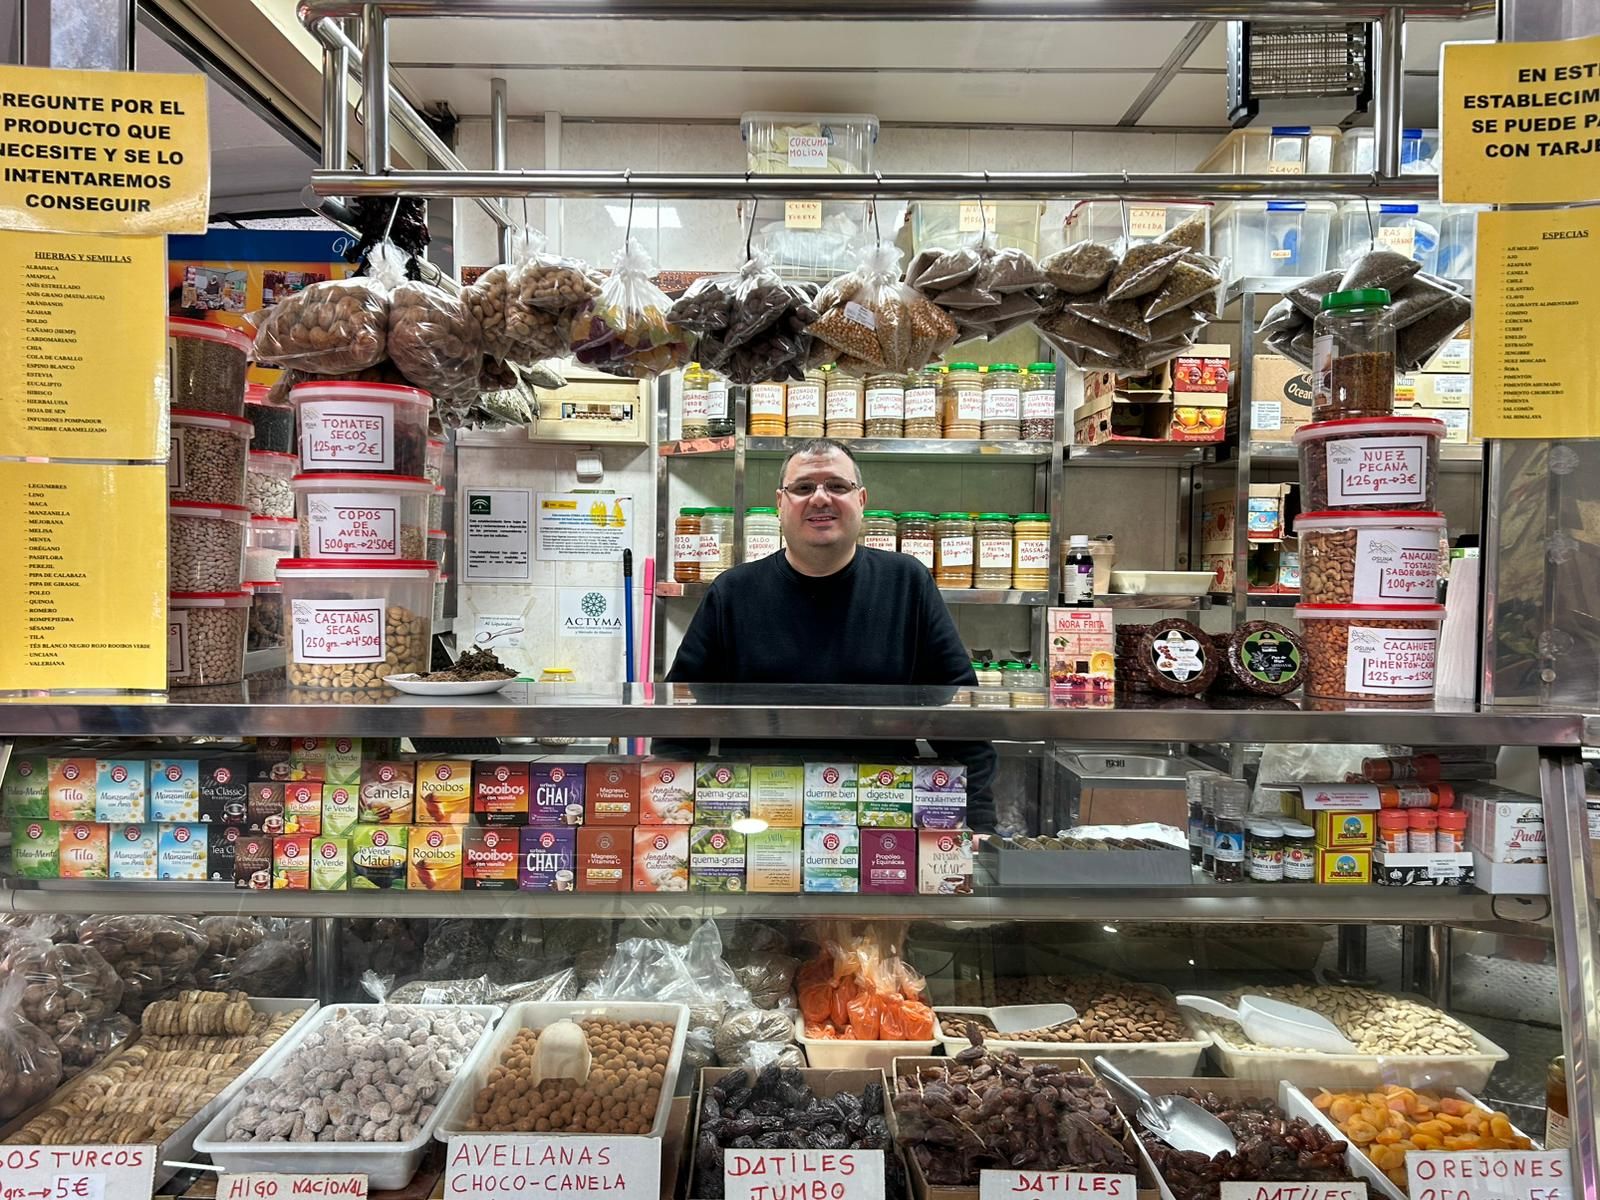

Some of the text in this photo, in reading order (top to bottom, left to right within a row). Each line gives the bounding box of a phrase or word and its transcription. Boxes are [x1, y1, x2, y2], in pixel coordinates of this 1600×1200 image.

[1519, 63, 1600, 82] EN EST
[111, 99, 153, 114] POR
[160, 101, 185, 115] EL
[4, 118, 170, 139] PRODUCTO QUE
[1472, 120, 1497, 133] SE
[1505, 116, 1576, 132] PUEDE
[1486, 144, 1529, 157] CON
[104, 148, 117, 161] Y
[124, 149, 150, 163] SE
[158, 151, 183, 165] LO
[4, 168, 170, 188] INTENTAREMOS
[26, 194, 150, 212] CONSEGUIR
[1542, 230, 1589, 240] ESPECIAS
[35, 252, 76, 260] HIERBAS
[86, 254, 132, 263] SEMILLAS
[321, 419, 379, 430] TOMATES
[330, 430, 366, 440] SECOS
[357, 442, 379, 455] 2€
[1364, 451, 1405, 461] NUEZ
[1360, 462, 1408, 472] PECANA
[1400, 474, 1416, 485] 3€
[338, 511, 381, 520] COPOS
[1386, 568, 1414, 576] SABOR
[315, 612, 374, 624] CASTAÑAS
[565, 618, 622, 626] ACTYMA
[1059, 618, 1080, 628] ÑORA
[326, 626, 360, 635] SECAS
[201, 787, 242, 795] Tea Classic
[364, 785, 410, 799] Canela
[421, 781, 464, 792] Rooibos
[479, 783, 524, 794] Rooibos
[60, 788, 83, 800] Tila
[101, 792, 138, 801] Manzanilla
[537, 788, 568, 806] CHAI
[698, 790, 748, 799] quema-grasa
[806, 789, 855, 798] duerme bien
[867, 790, 904, 800] digestive
[16, 849, 57, 858] Poleo-Menta
[71, 849, 93, 860] Tila
[114, 851, 152, 860] Manzanilla
[412, 847, 456, 859] Rooibos
[468, 849, 513, 861] Rooibos
[360, 855, 401, 866] Matcha
[692, 856, 744, 865] quema-grasa
[806, 856, 856, 865] duerme bien
[51, 1150, 143, 1168] TURCOS
[451, 1143, 610, 1167] AVELLANAS
[728, 1152, 855, 1176] DATILES
[1416, 1157, 1563, 1180] OREJONES
[57, 1177, 89, 1198] 5€
[230, 1176, 366, 1198] HIGO NACIONAL
[451, 1174, 625, 1193] CHOCO-CANELA
[1012, 1174, 1121, 1195] DATILES
[750, 1182, 845, 1200] JUMBO
